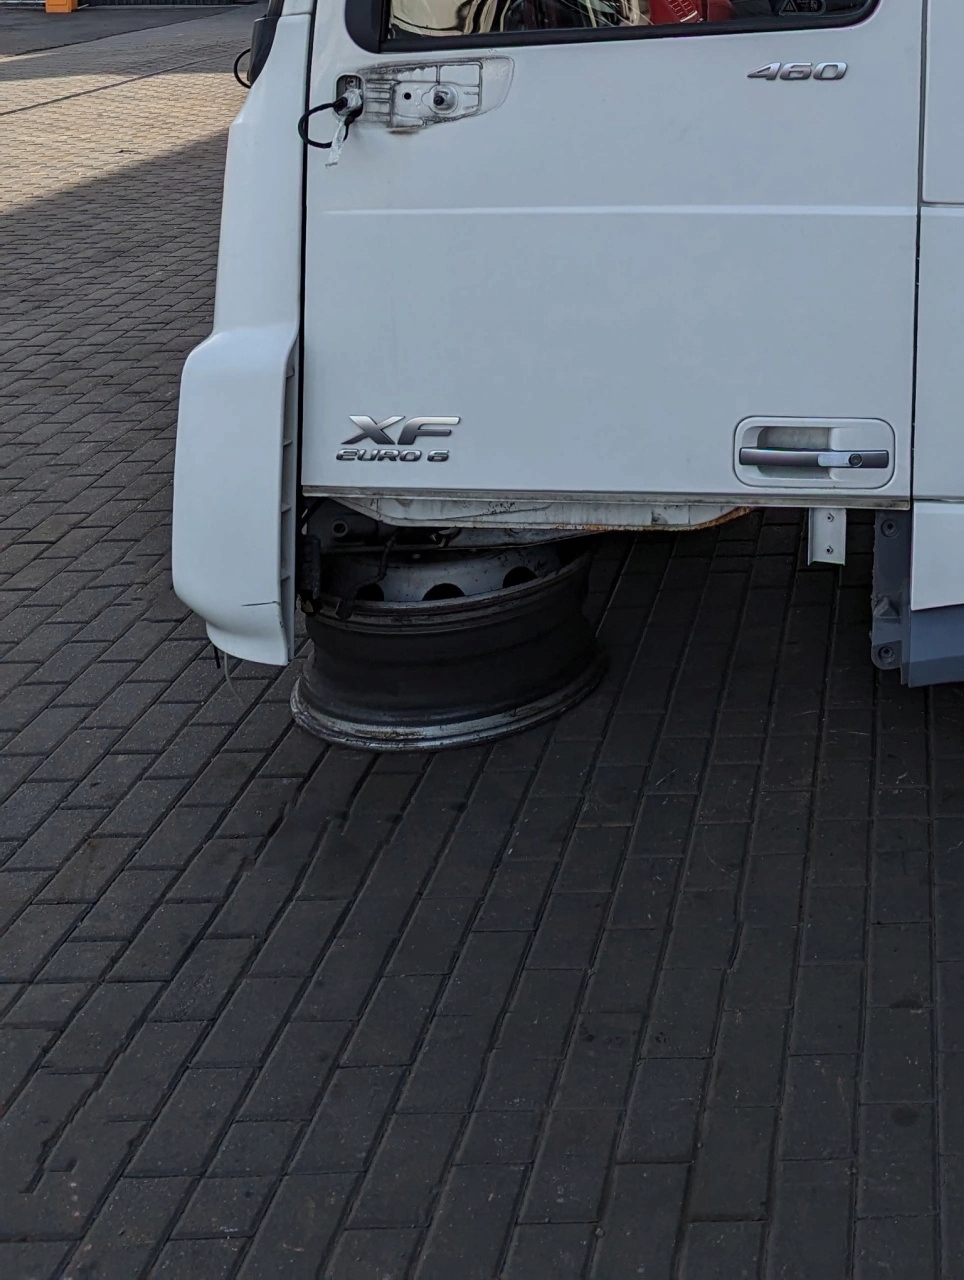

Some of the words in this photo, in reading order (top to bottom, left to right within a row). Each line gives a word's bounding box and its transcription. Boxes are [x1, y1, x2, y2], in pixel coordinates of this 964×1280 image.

[746, 61, 849, 81] 460
[340, 414, 461, 445] XF
[335, 448, 422, 462] EURO
[427, 449, 450, 462] 6
